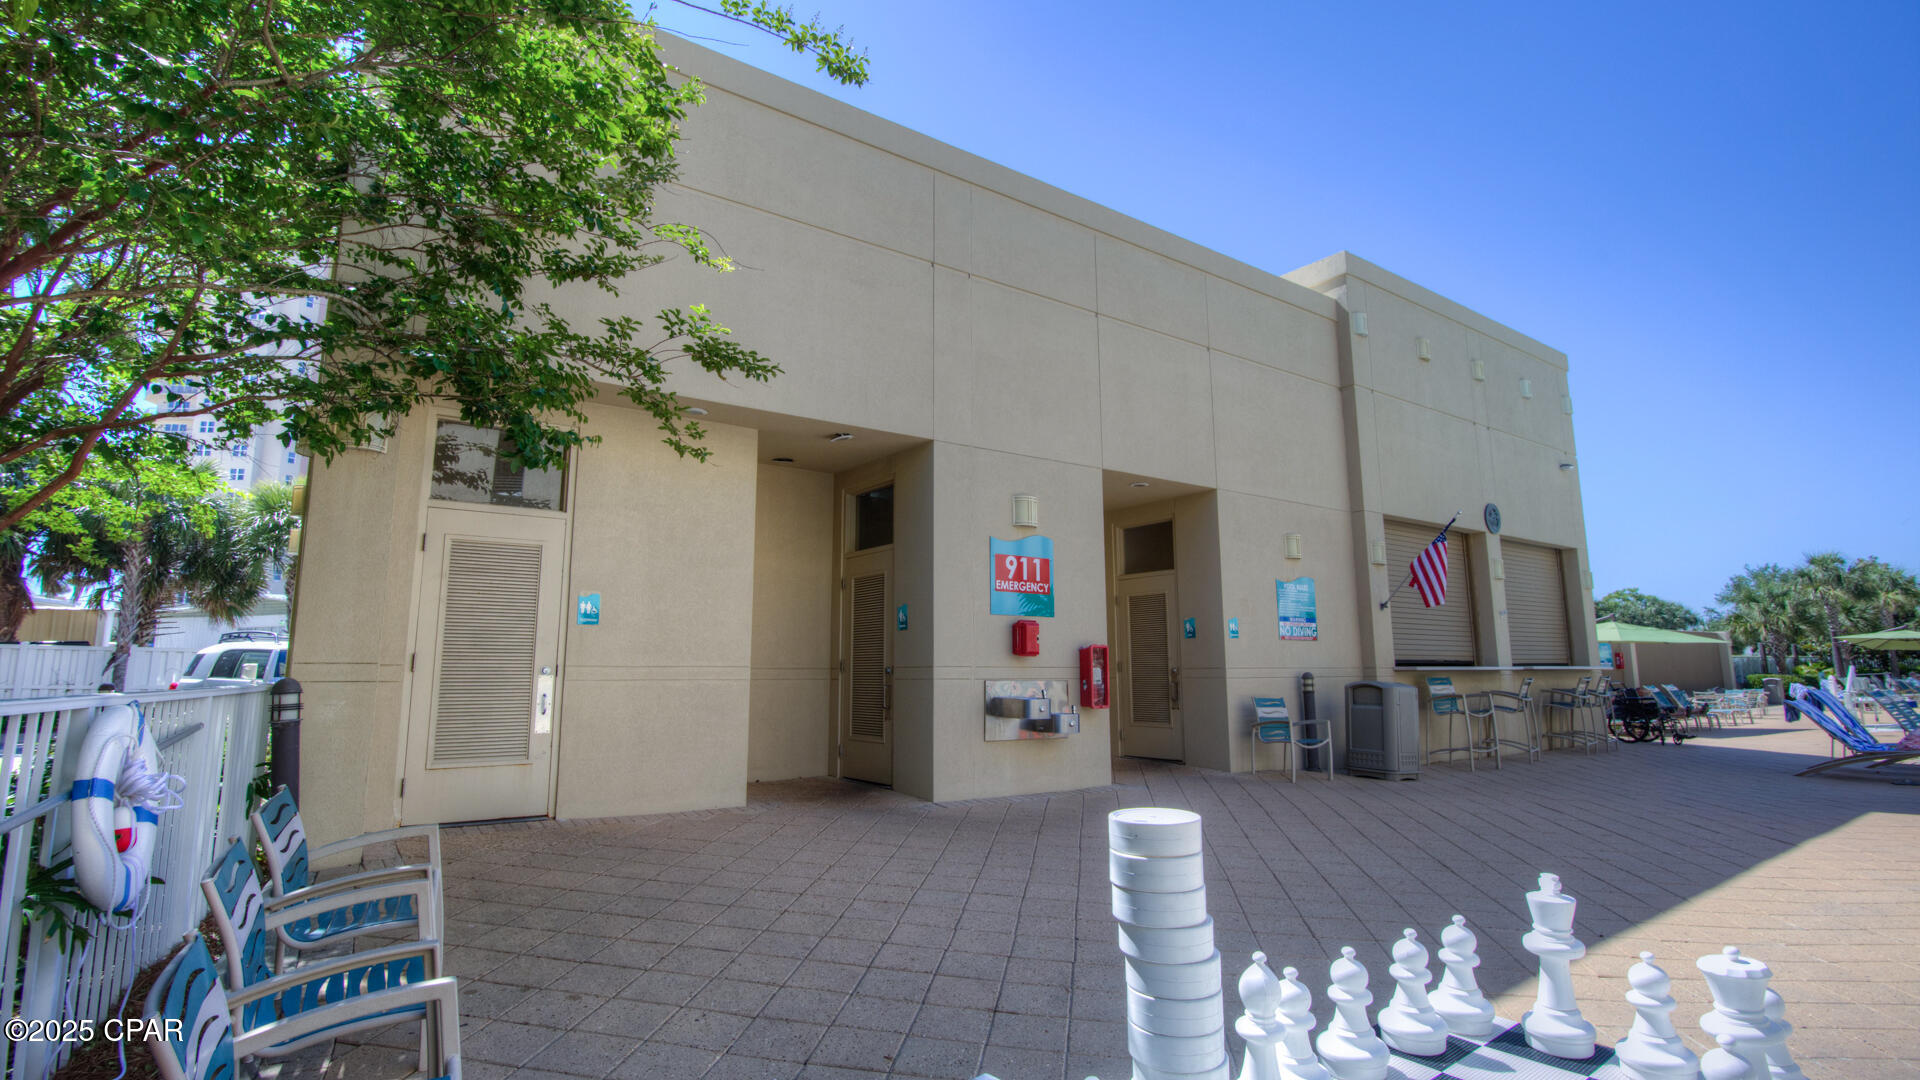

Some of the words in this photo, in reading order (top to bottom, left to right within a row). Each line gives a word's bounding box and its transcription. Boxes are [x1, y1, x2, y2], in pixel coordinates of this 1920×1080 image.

[1005, 555, 1041, 581] 911
[996, 579, 1049, 593] EMERGENCY
[1280, 624, 1291, 636] NO
[1293, 625, 1317, 637] DIVING
